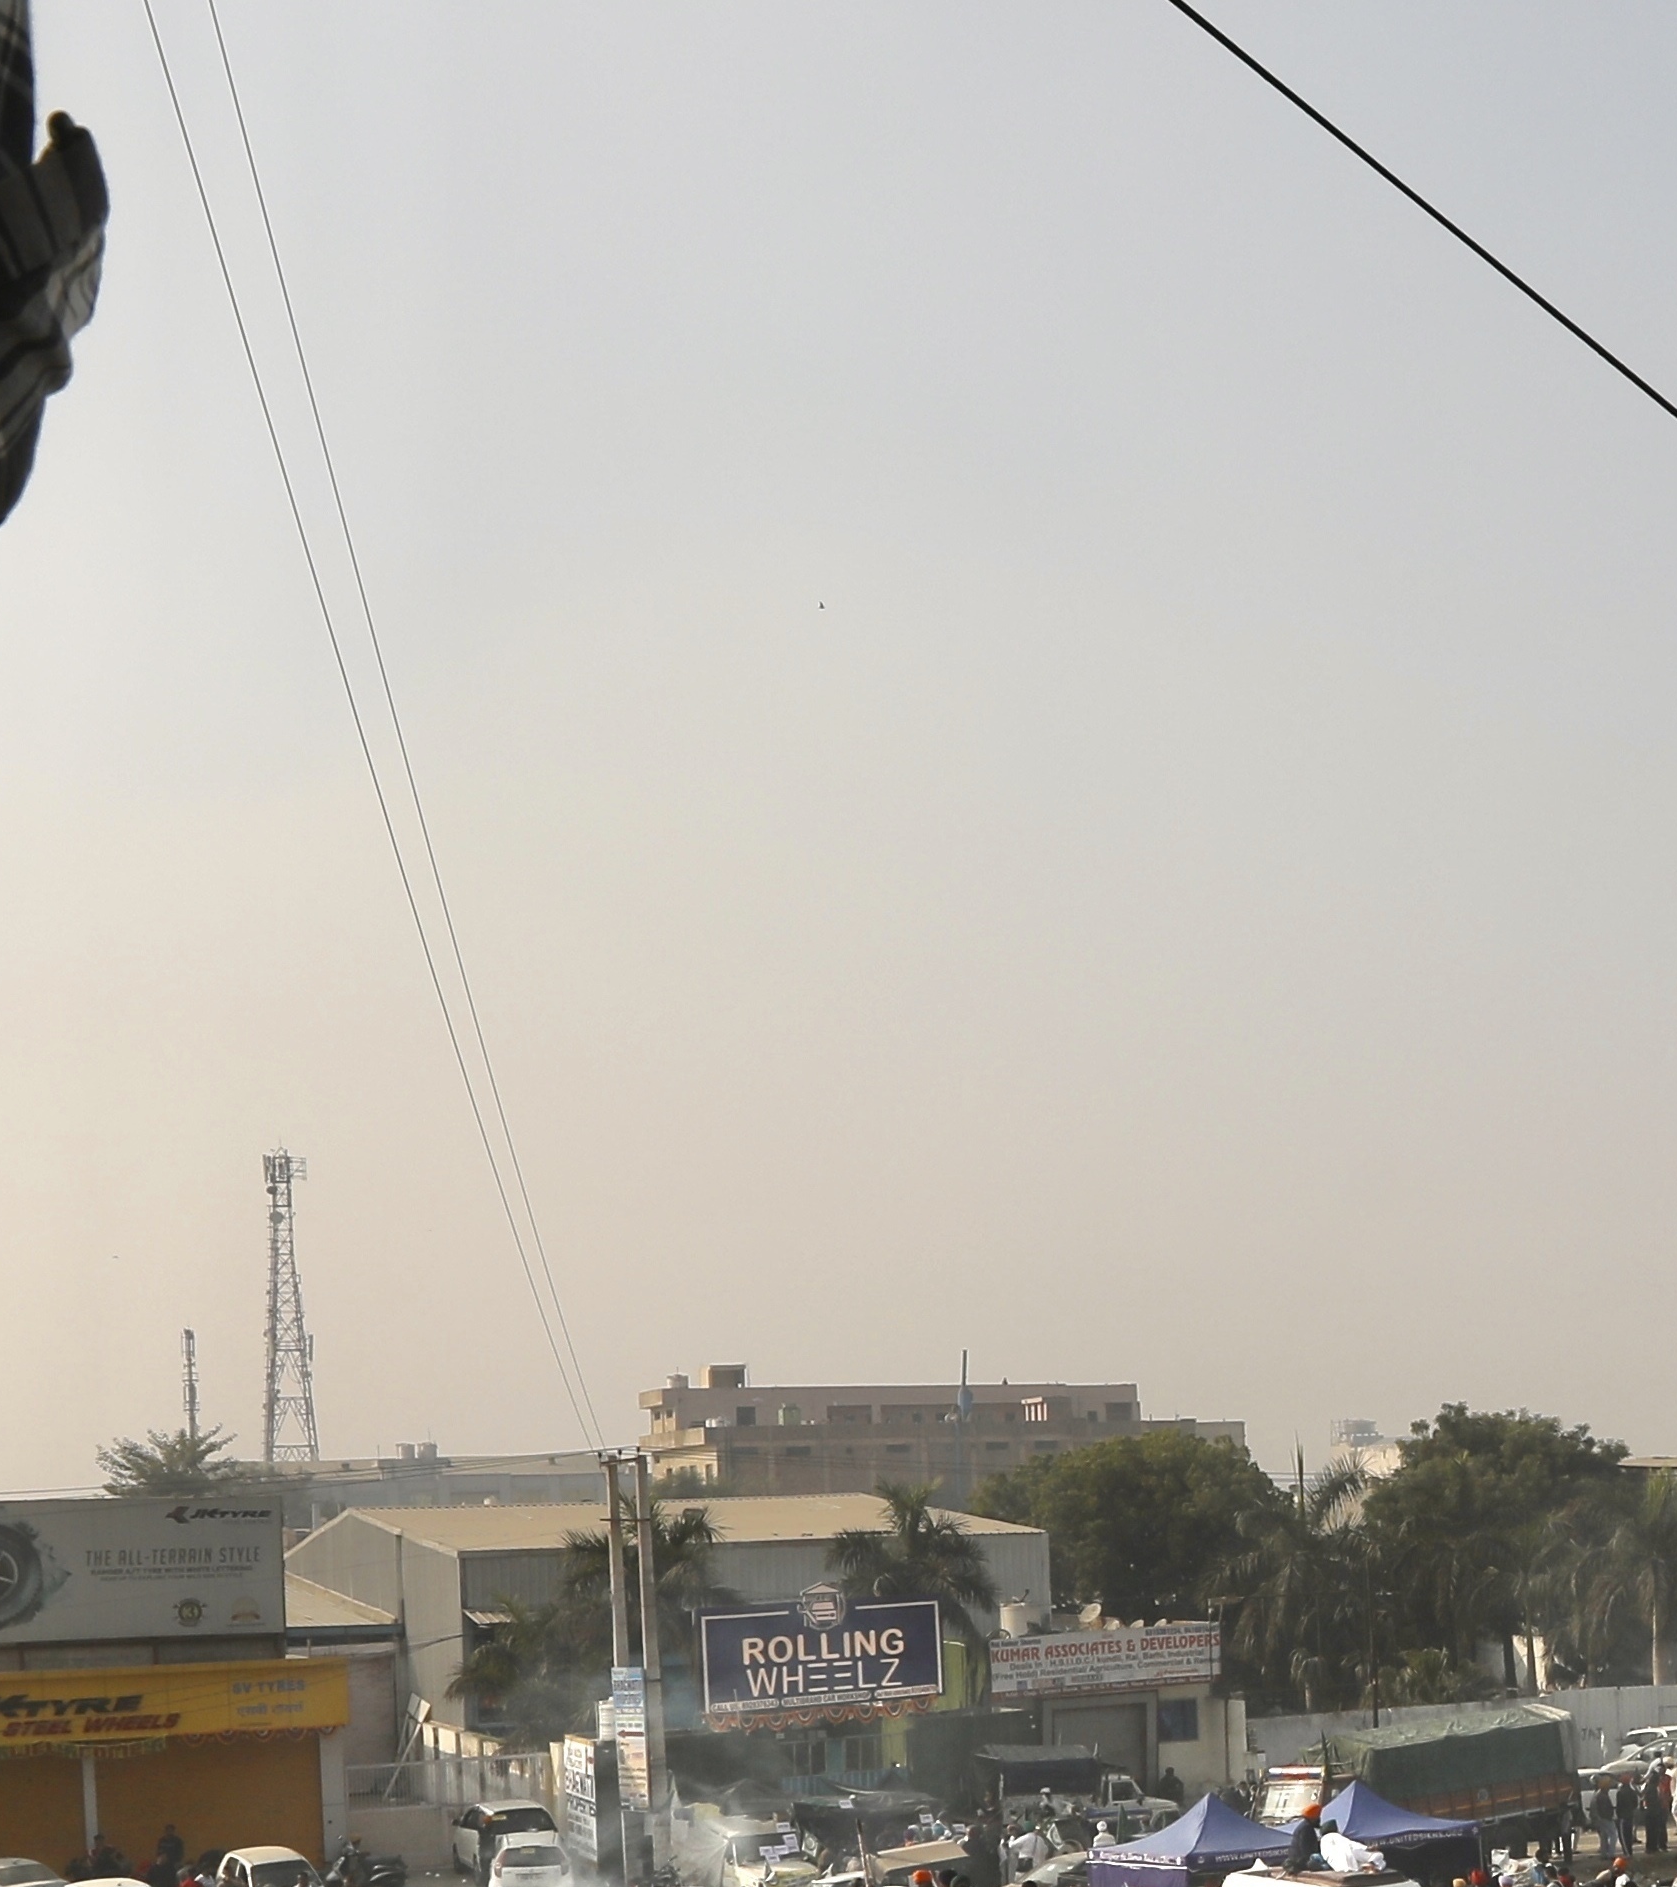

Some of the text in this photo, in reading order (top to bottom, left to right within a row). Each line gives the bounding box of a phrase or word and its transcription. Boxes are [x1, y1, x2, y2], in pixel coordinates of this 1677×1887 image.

[86, 1546, 260, 1566] THE ALL-TERRAIN STYLE
[742, 1628, 905, 1666] ROLLING
[991, 1633, 1220, 1663] KUMAR ASSOCIATES & DEVELOPERS
[746, 1658, 903, 1697] WHEELZ
[2, 1713, 181, 1738] STEEL WHEELS
